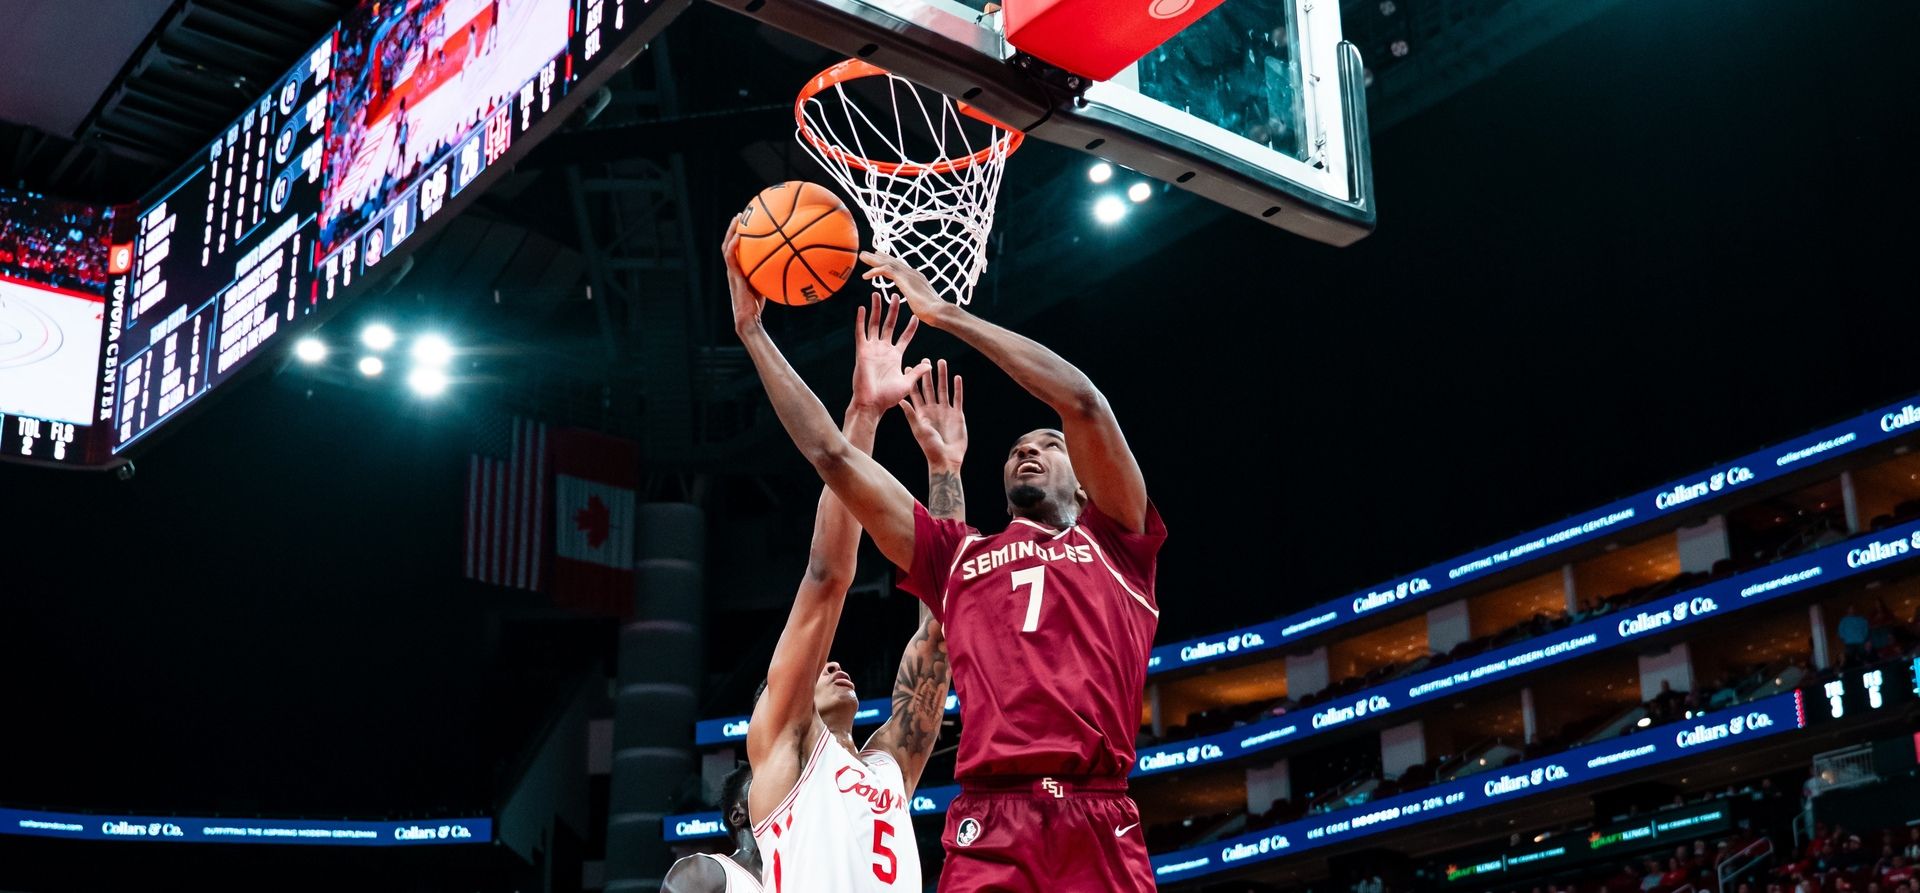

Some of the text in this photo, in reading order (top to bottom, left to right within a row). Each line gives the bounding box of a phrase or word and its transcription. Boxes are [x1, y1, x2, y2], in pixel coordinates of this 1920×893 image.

[100, 275, 127, 421] TOYOTA CENTER
[18, 416, 75, 443] TOL FLS
[1881, 405, 1920, 432] Colla
[21, 436, 34, 456] 2
[1777, 433, 1856, 466] collarsandco.com
[1656, 467, 1754, 509] Collars & Co.
[1493, 551, 1509, 563] THE
[1546, 526, 1583, 545] MODERN
[1583, 508, 1634, 532] GENTLEMAN
[962, 540, 1094, 580] SEMINOLES
[1847, 538, 1909, 568] Collars
[1353, 578, 1431, 613] Collars & Co.
[1741, 567, 1822, 597] collarsandco.com
[1011, 565, 1046, 632] 7
[1619, 597, 1718, 637] Collars & Co.
[1181, 633, 1264, 661] Collars & Co.
[1454, 672, 1470, 683] THE
[1507, 650, 1544, 667] MODERN
[1544, 634, 1596, 656] GENTLEMAN
[1312, 696, 1390, 729] Collars & Co.
[722, 720, 750, 737] Coll
[1677, 712, 1773, 748] Collars & Co.
[1140, 744, 1223, 771] Collars & Co.
[1588, 745, 1656, 768] collarsandco.com
[1041, 777, 1064, 798] FSU
[1484, 765, 1568, 797] Collars & Co.
[913, 797, 936, 811] Co.
[1402, 803, 1421, 815] FOR
[1423, 797, 1444, 810] 20%
[102, 821, 183, 836] Collars & Co.
[395, 825, 471, 840] Collars & Co.
[676, 819, 718, 836] Collars
[872, 819, 897, 885] 5
[1222, 835, 1290, 862] Collars & Co.
